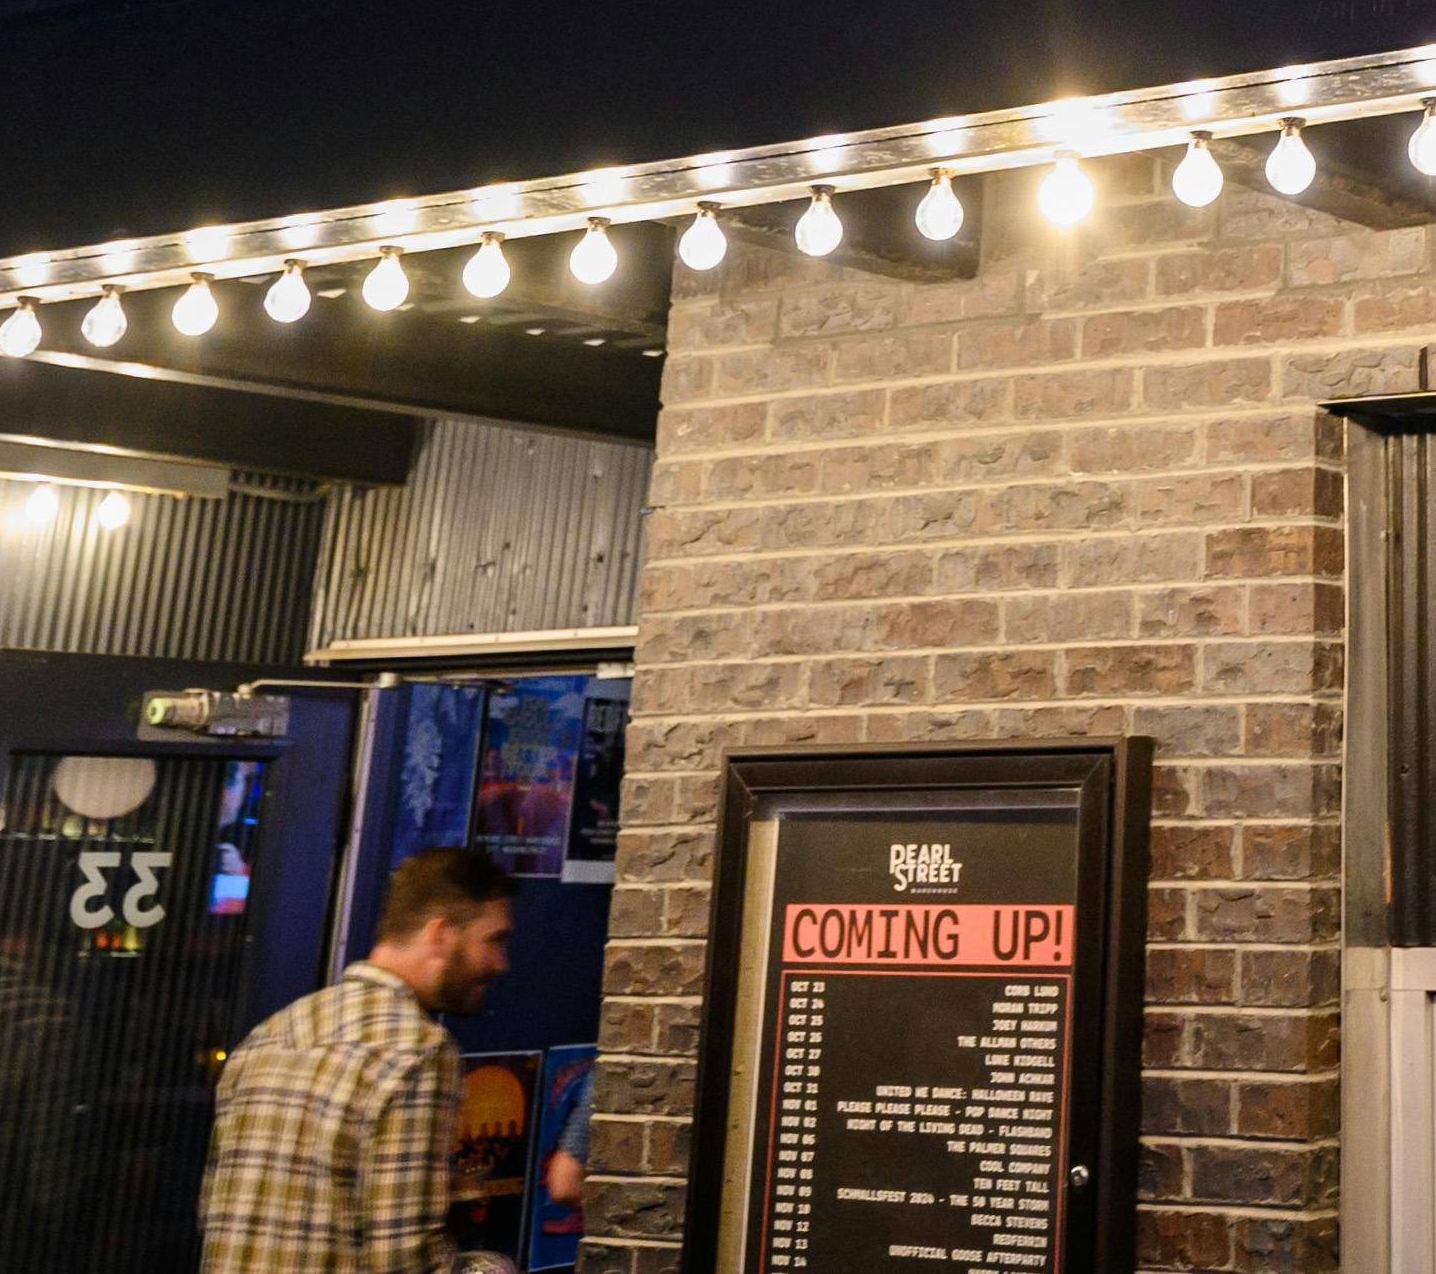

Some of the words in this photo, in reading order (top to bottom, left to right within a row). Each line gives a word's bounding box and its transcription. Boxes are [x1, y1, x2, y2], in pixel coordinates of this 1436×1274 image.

[889, 843, 954, 874] PEARL
[893, 862, 963, 892] STREET
[792, 908, 960, 961] COMING
[992, 909, 1063, 963] UP!
[791, 981, 809, 992] OCT
[789, 998, 808, 1009] OCT
[789, 1014, 807, 1025] OCT
[787, 1031, 806, 1042] OCT
[786, 1048, 805, 1059] OCT
[785, 1065, 804, 1076] OCT
[784, 1082, 802, 1092] OCT
[783, 1099, 801, 1109] NOV
[782, 1116, 800, 1126] NOV
[780, 1133, 799, 1144] NOV
[779, 1151, 798, 1161] NOV
[778, 1168, 797, 1178] NOV
[777, 1185, 795, 1195] NOV
[775, 1203, 794, 1213] NOV
[774, 1220, 793, 1230] NOV
[773, 1237, 791, 1248] NOV
[772, 1255, 790, 1265] NOV
